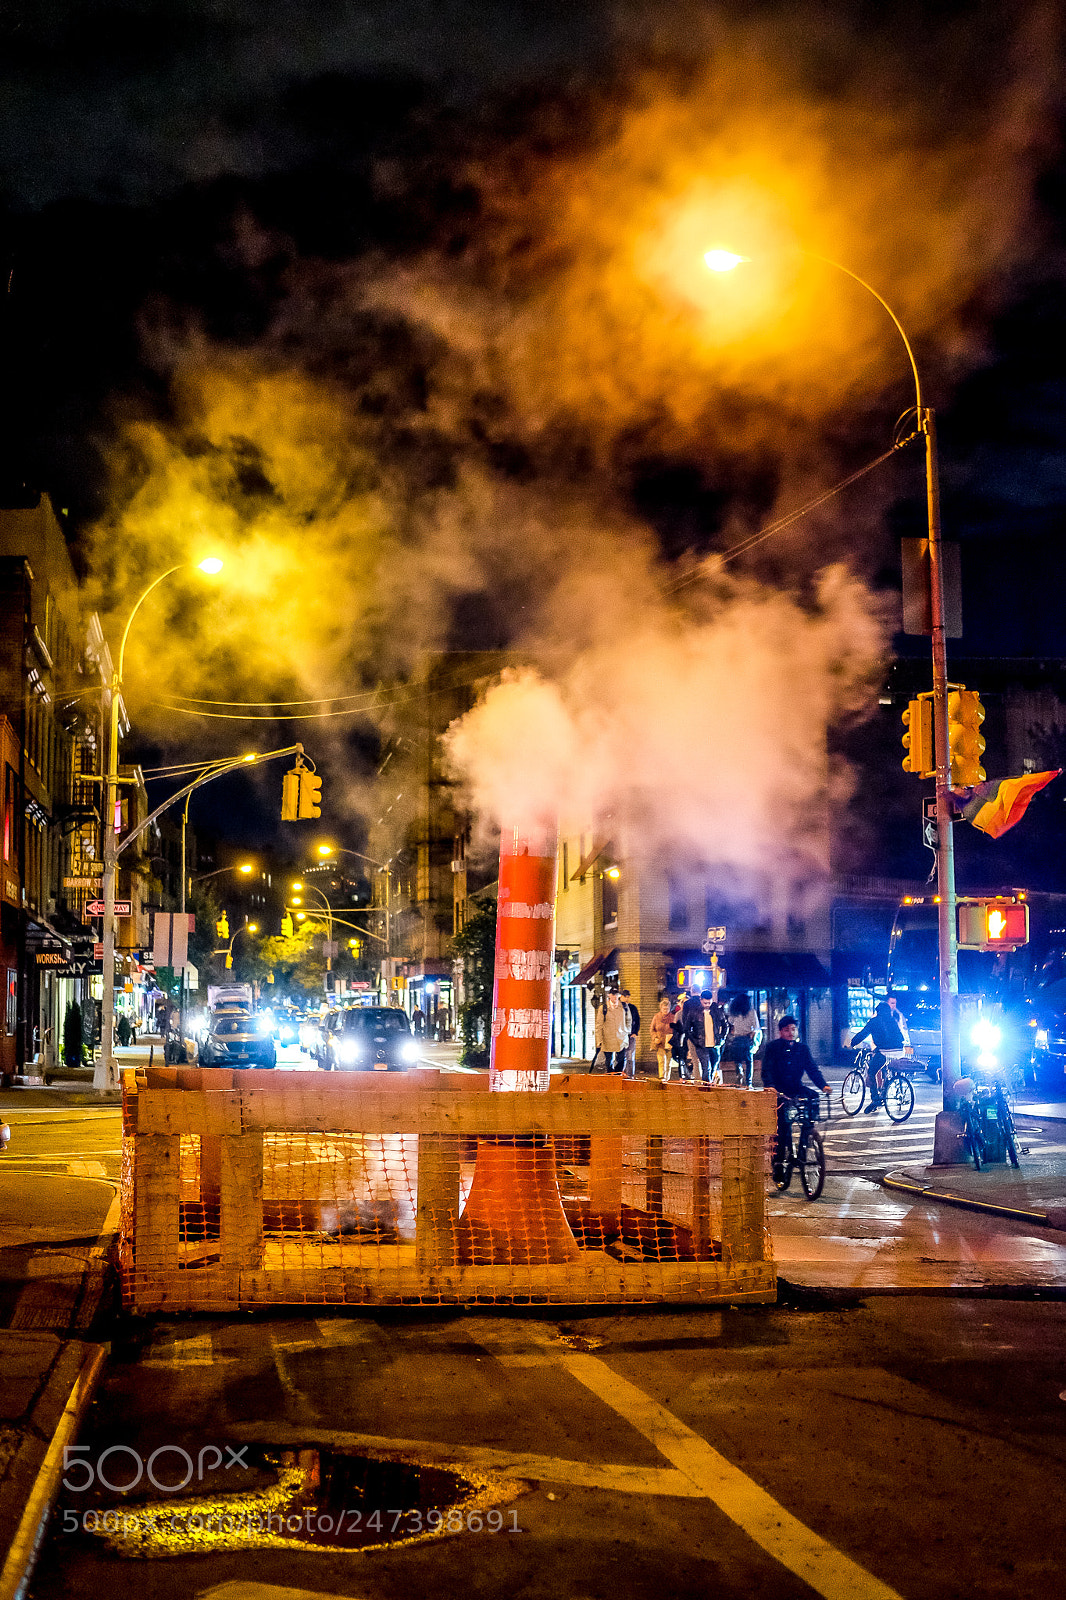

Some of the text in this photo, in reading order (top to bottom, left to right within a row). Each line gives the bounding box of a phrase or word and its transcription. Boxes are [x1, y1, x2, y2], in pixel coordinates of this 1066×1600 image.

[66, 878, 102, 887] BARROW ST
[36, 953, 67, 964] WORKSH
